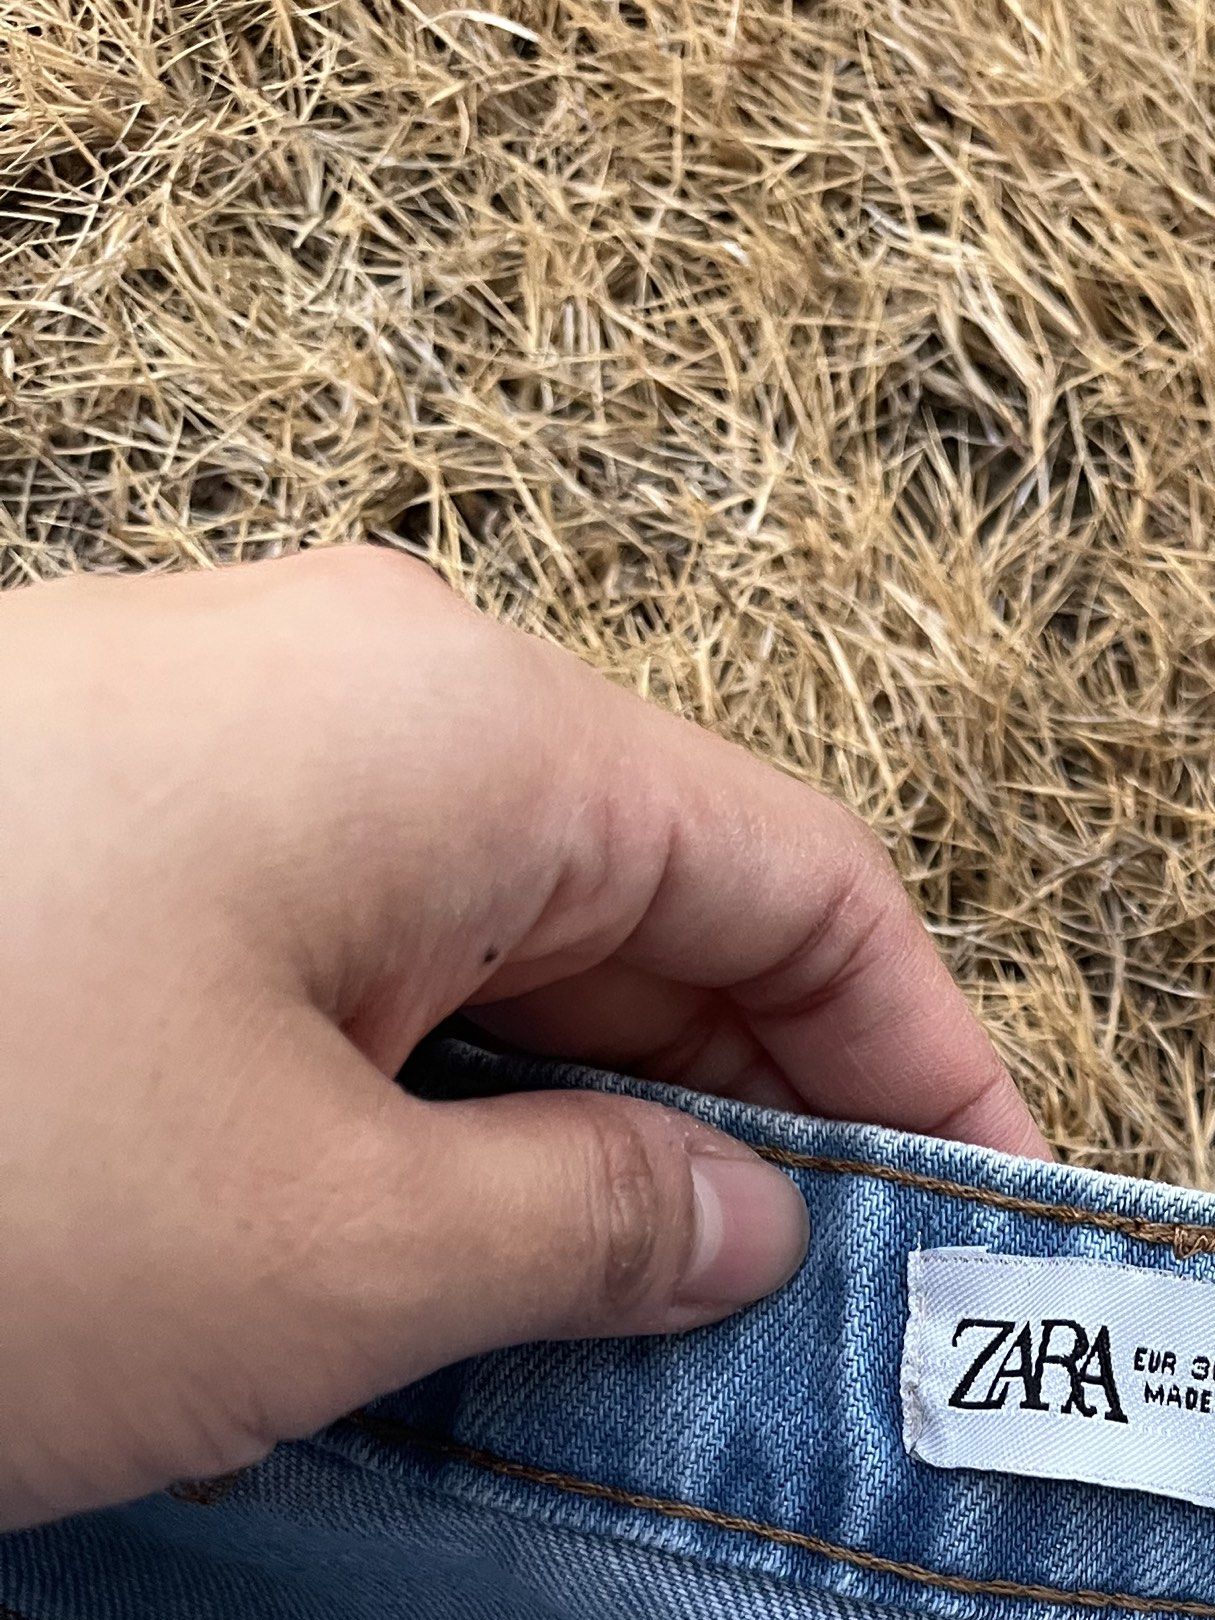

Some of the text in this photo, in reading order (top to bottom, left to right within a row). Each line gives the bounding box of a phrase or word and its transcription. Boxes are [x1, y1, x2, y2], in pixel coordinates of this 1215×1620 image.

[948, 1318, 1129, 1424] ZARA
[1133, 1346, 1177, 1376] EUR
[1143, 1380, 1213, 1414] MADE
